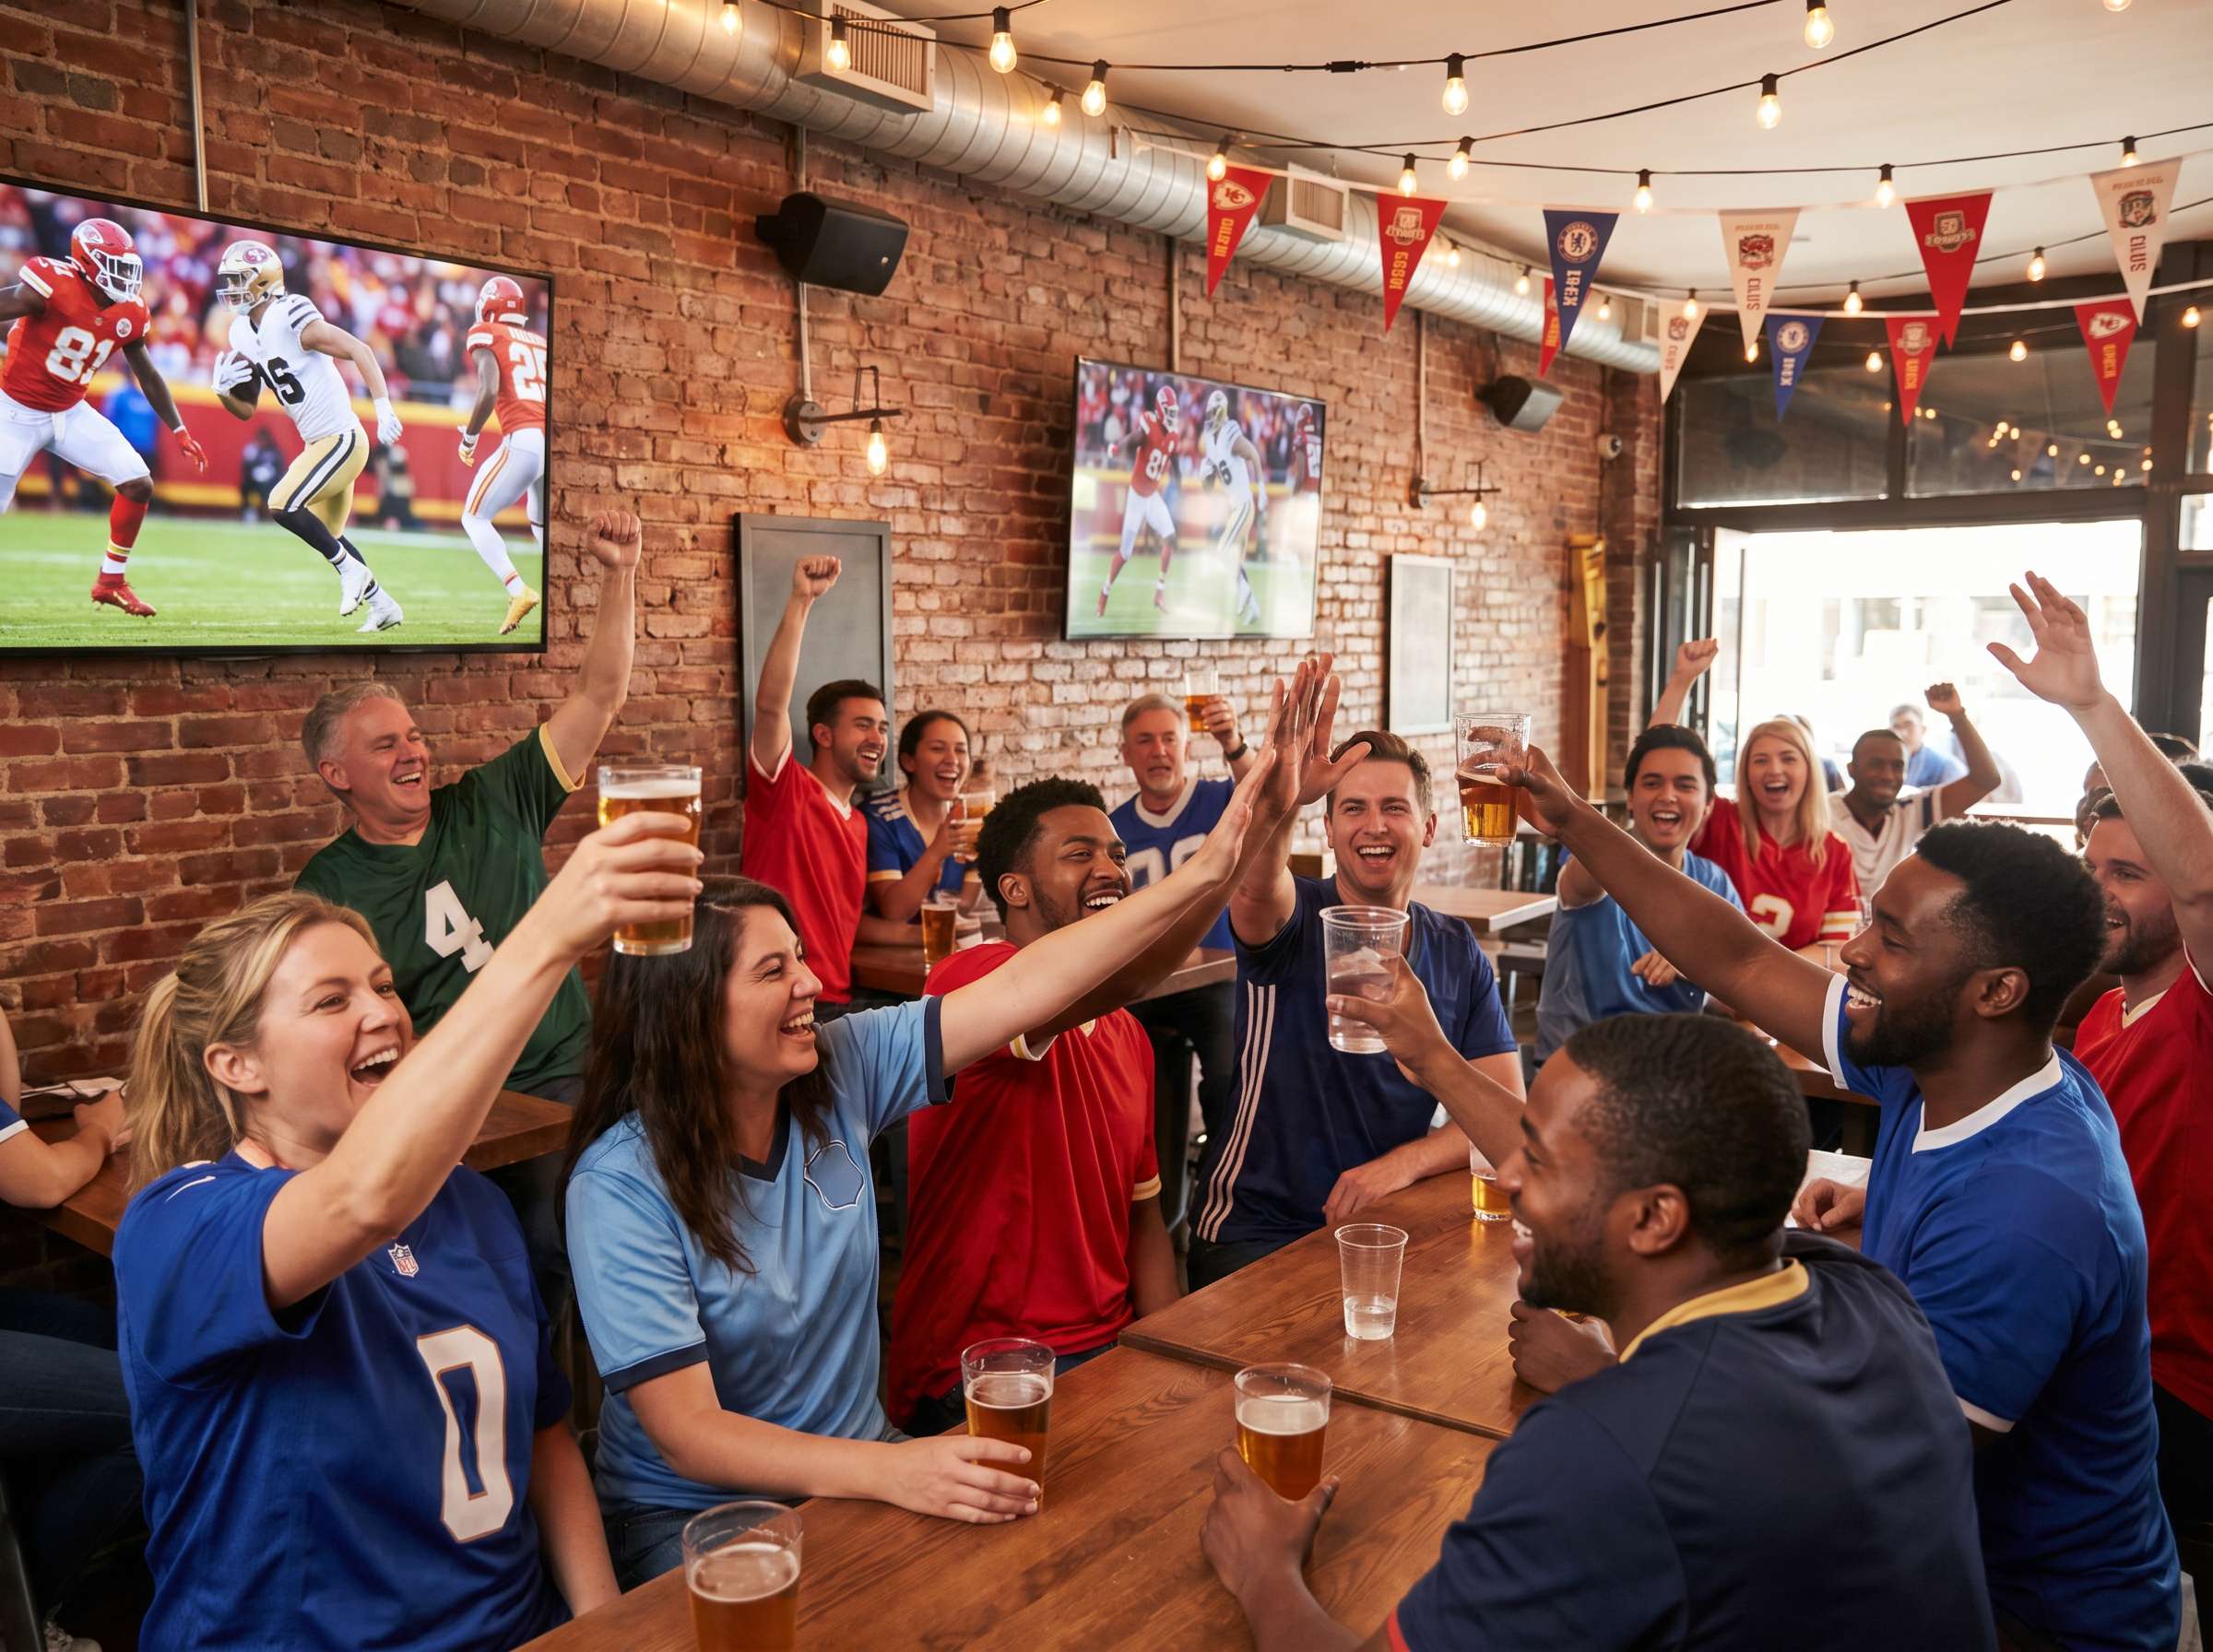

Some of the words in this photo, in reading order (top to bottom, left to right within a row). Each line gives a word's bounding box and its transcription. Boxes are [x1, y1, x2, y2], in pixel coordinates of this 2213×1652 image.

[44, 325, 114, 384] 81
[425, 879, 496, 974] 4
[417, 1324, 515, 1544] 0
